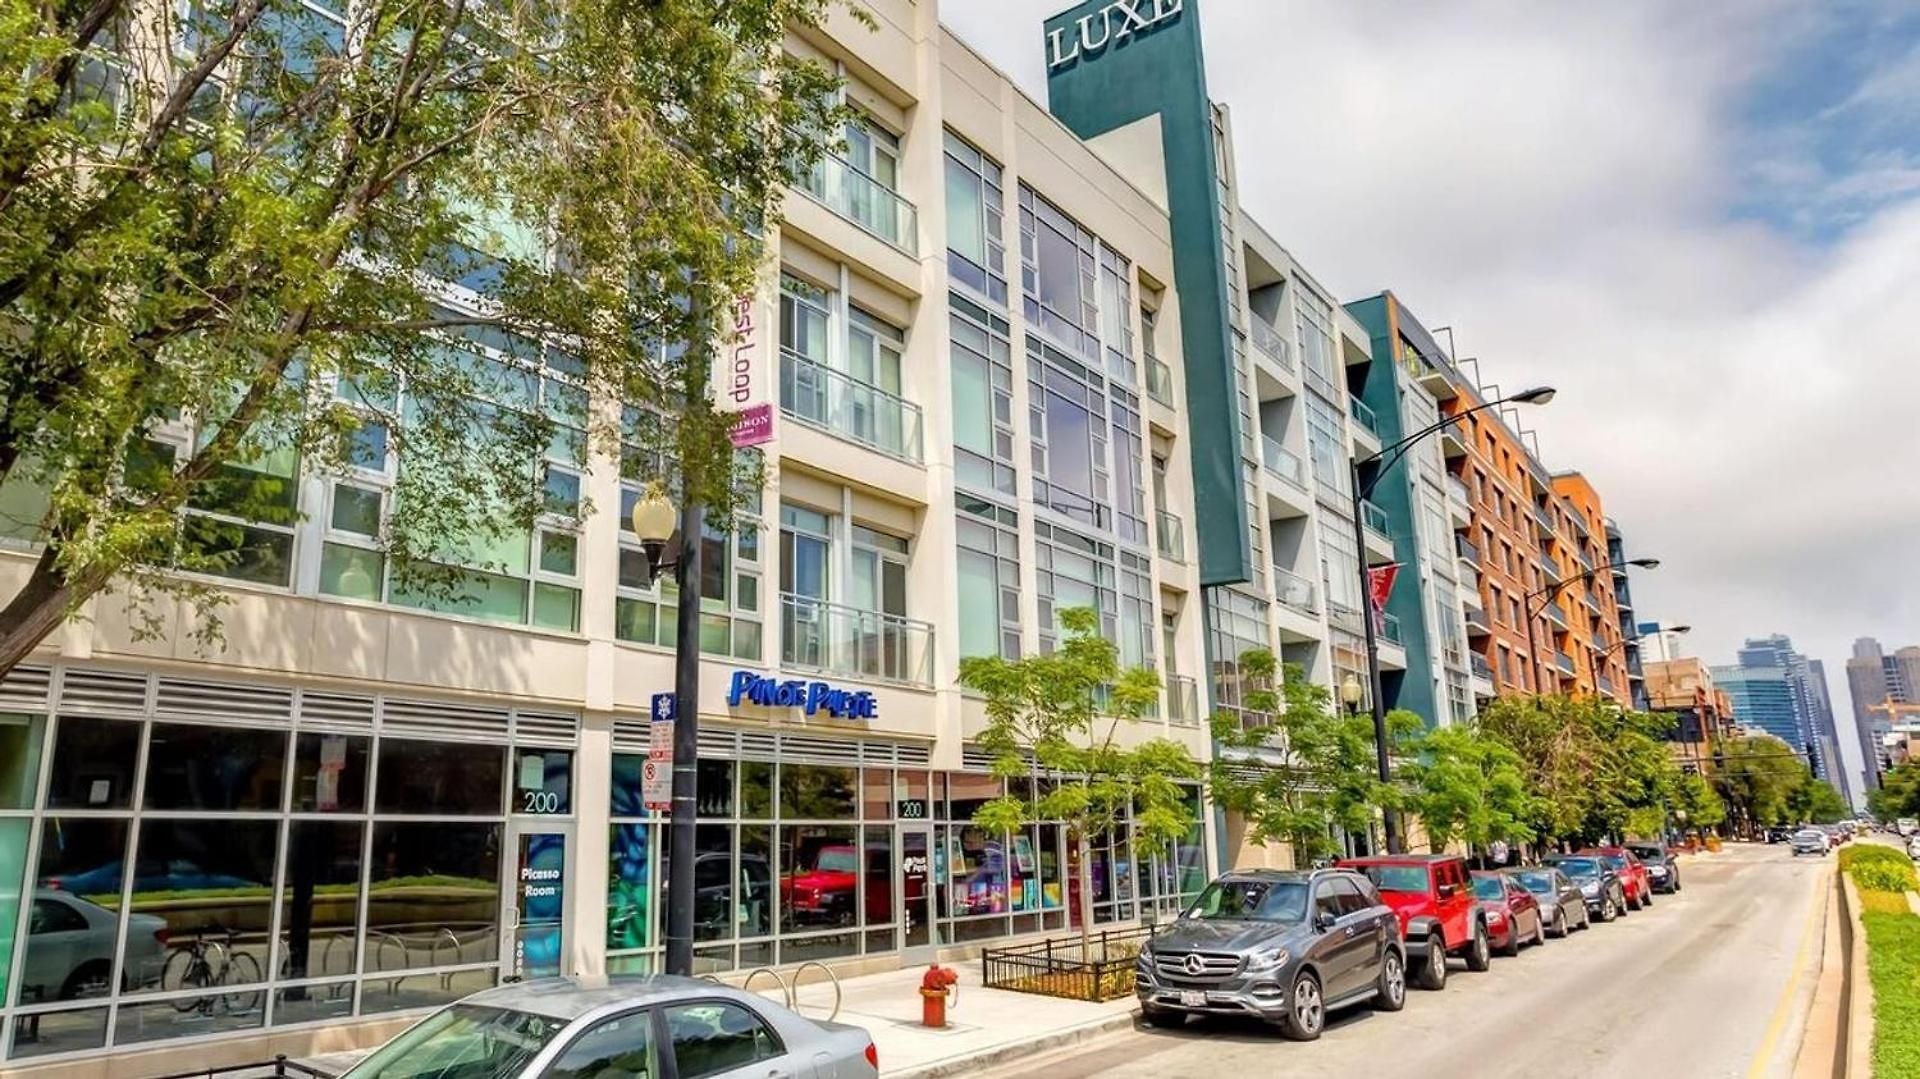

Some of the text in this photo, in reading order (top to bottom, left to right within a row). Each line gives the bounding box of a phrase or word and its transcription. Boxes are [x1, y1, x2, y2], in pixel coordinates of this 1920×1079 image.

[735, 294, 756, 338] est
[728, 343, 756, 403] Loop
[524, 791, 558, 813] 200
[902, 802, 922, 817] 200
[521, 868, 560, 881] Picasso
[525, 884, 555, 897] Room
